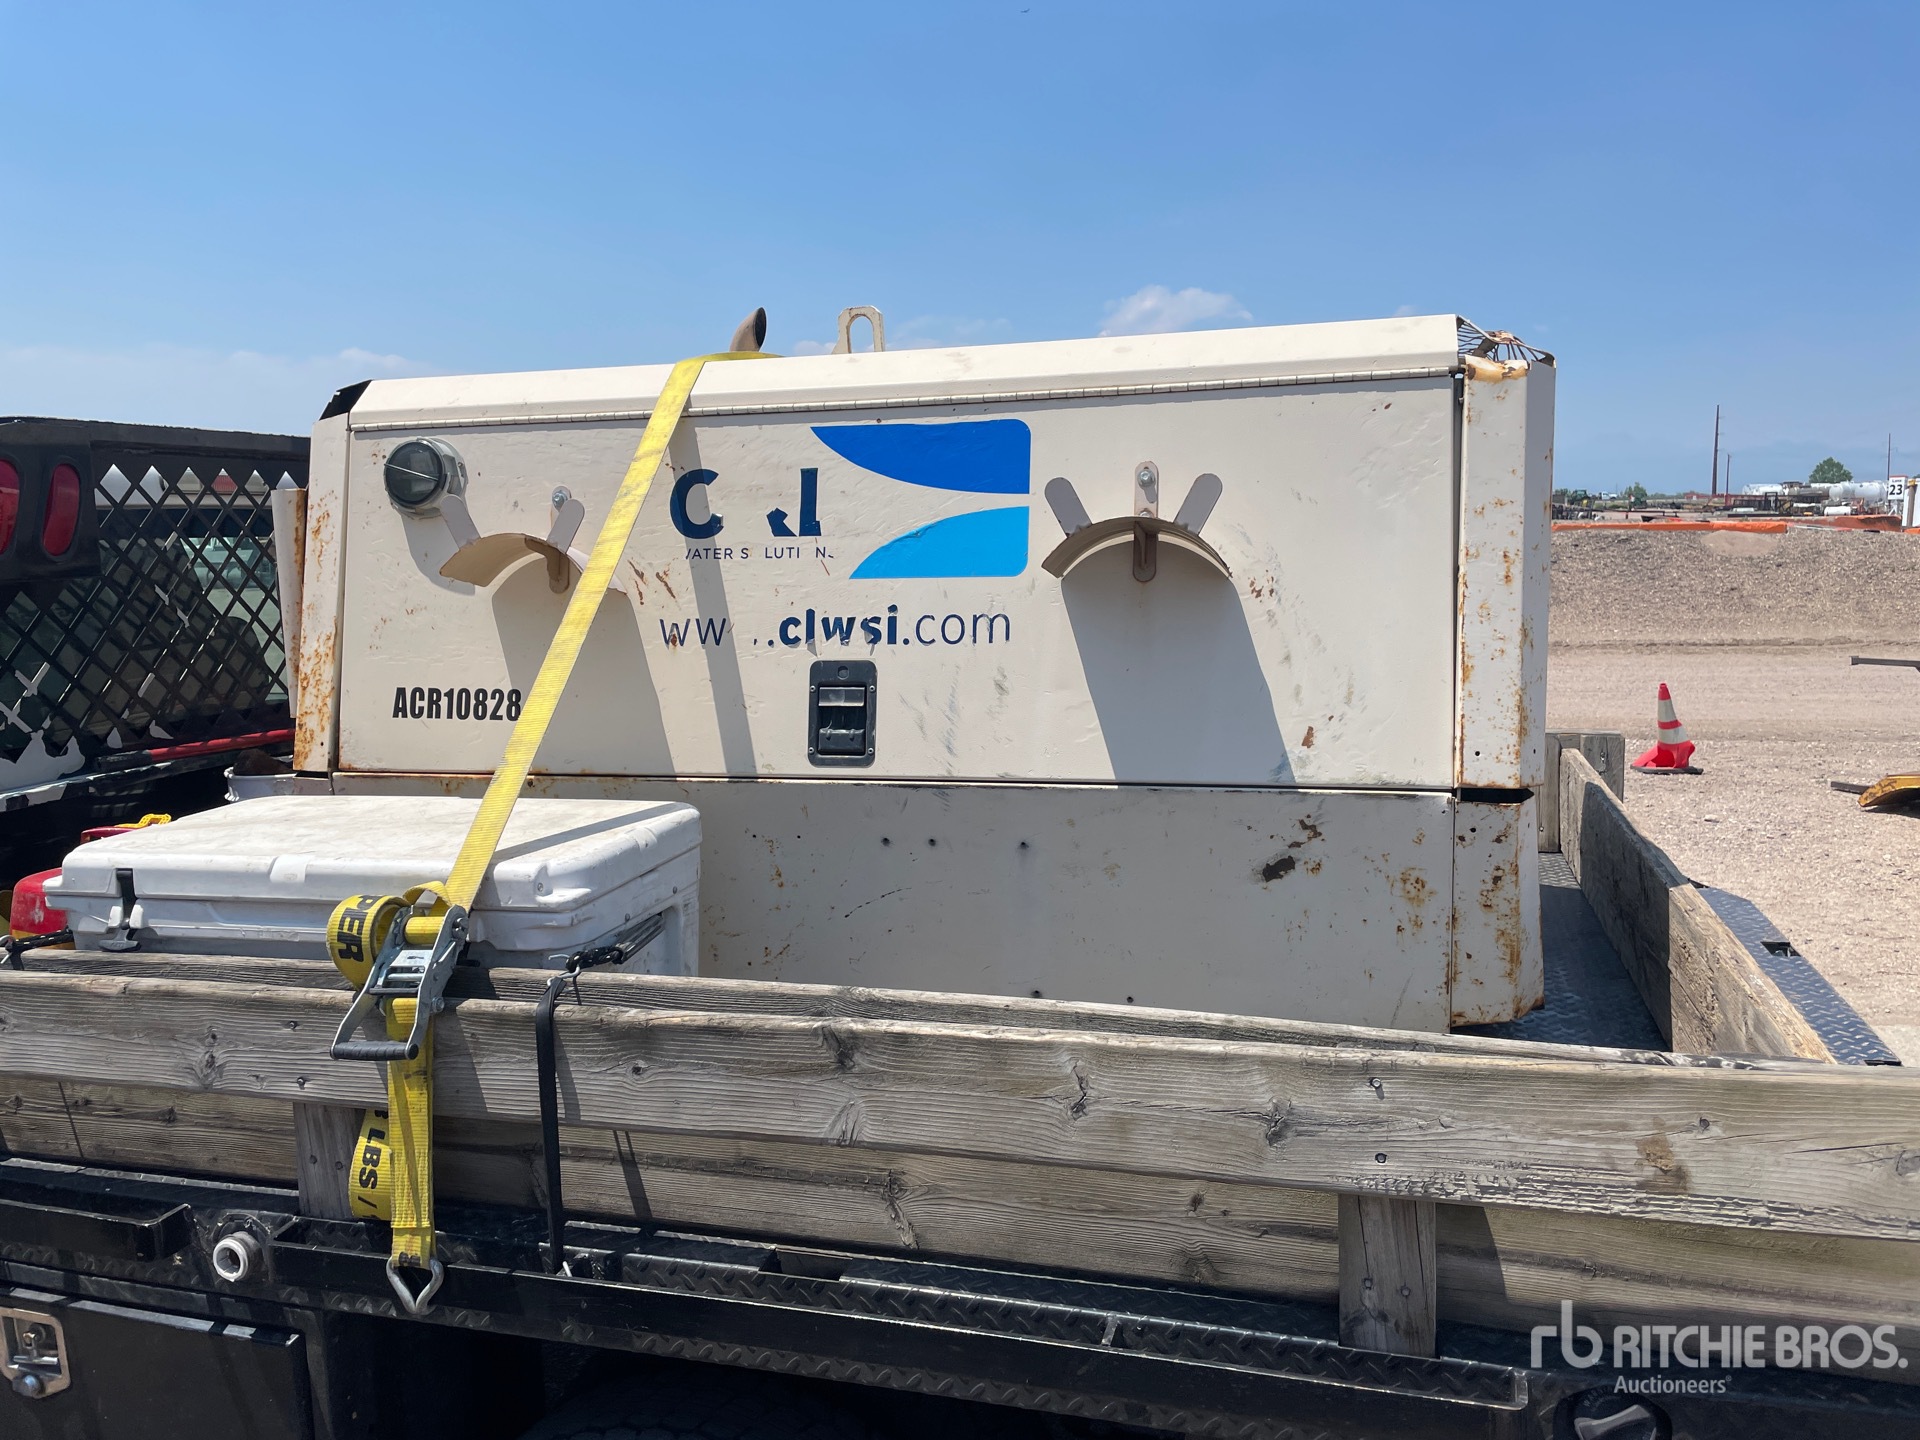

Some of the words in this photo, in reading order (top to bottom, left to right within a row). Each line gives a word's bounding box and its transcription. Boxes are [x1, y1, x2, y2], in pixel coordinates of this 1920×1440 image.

[1889, 484, 1903, 496] 23
[392, 687, 522, 721] ACR10828
[359, 1128, 386, 1189] LBS
